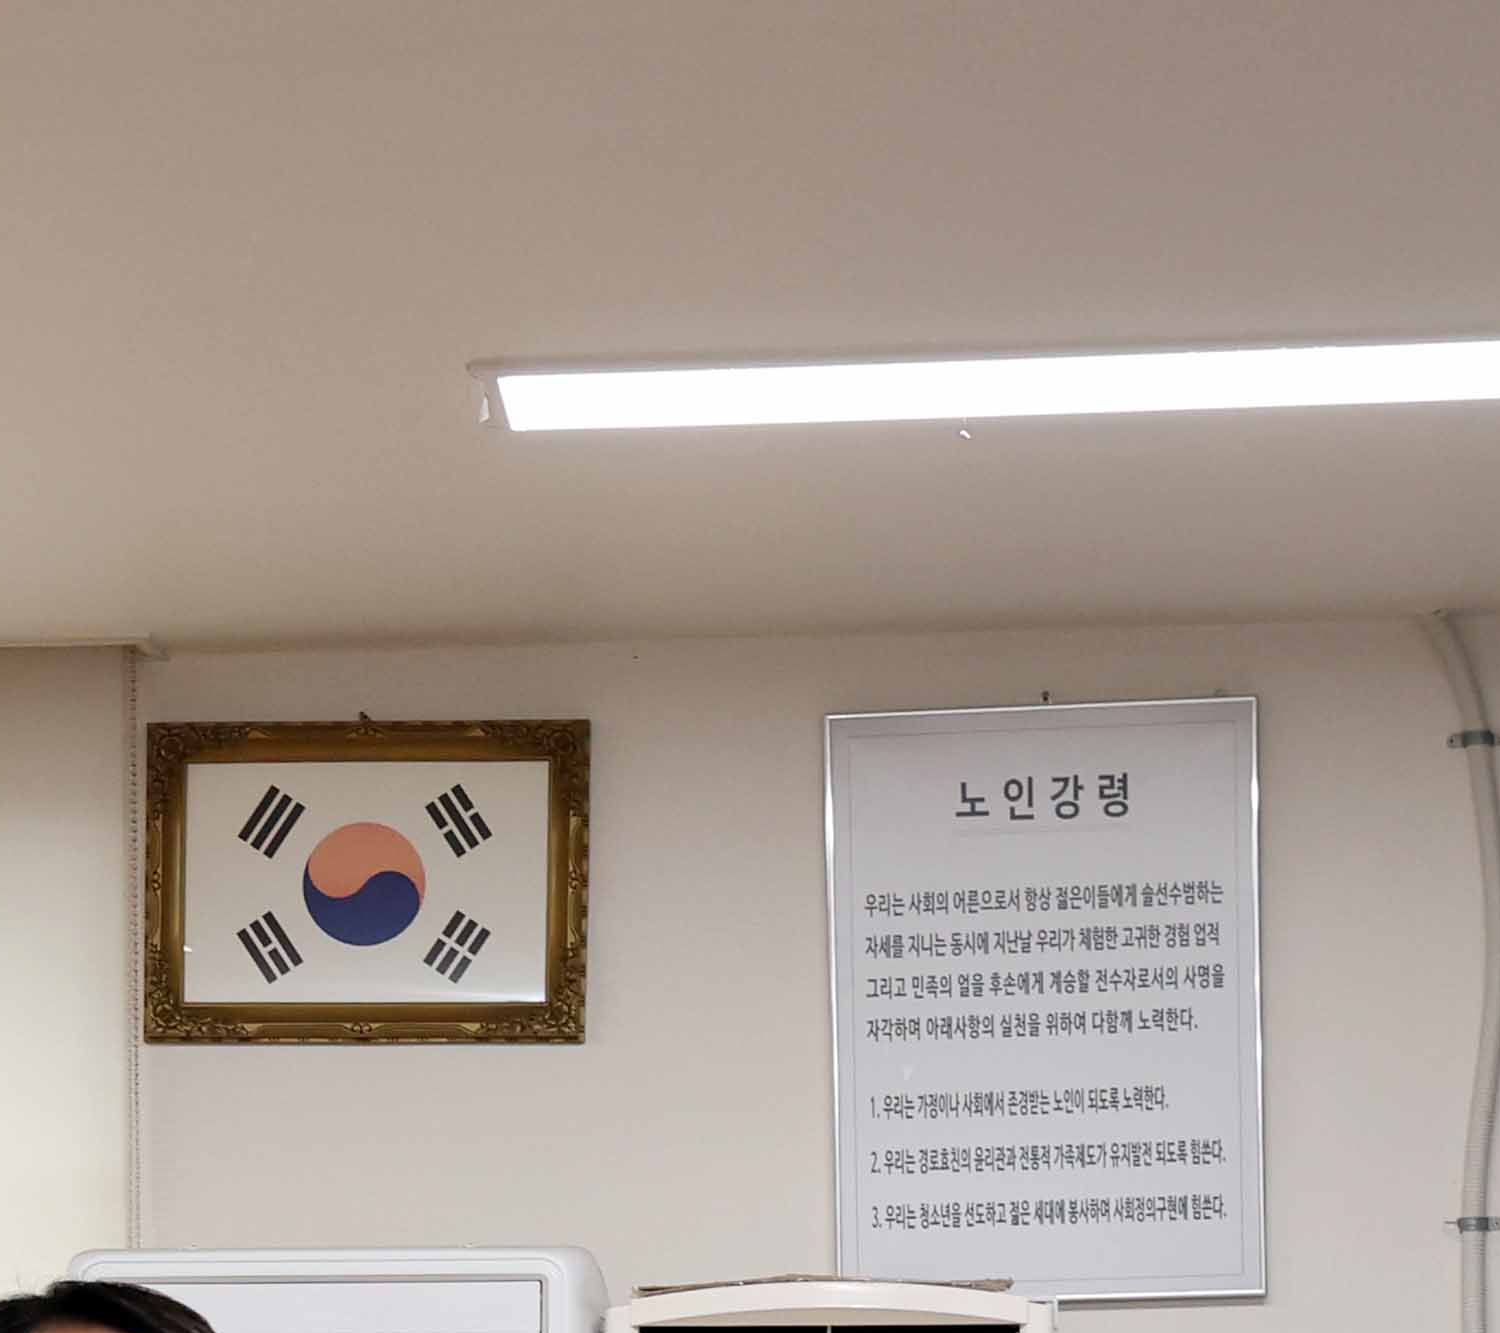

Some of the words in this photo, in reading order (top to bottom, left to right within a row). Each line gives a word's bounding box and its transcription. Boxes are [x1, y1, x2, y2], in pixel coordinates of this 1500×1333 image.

[955, 772, 1130, 821] 노인강령
[864, 892, 905, 918] 우리는
[908, 890, 949, 915] 사회의
[952, 888, 1020, 914] 어른으로서
[1024, 886, 1051, 912] 항상
[1055, 883, 1138, 910] 젊은이들에게
[1140, 880, 1224, 907] 솔선수범하는
[865, 934, 905, 959] 자세를
[908, 932, 947, 957] 지니는
[950, 930, 989, 956] 동시에
[993, 929, 1033, 954] 지난날
[1036, 927, 1076, 953] 우리가
[1079, 925, 1118, 951] 체험한
[1121, 924, 1161, 950] 고귀한
[1164, 923, 1191, 948] 경험
[1193, 921, 1220, 946] 업적
[865, 976, 907, 1000] 그리고
[911, 974, 952, 1000] 민족의
[958, 972, 985, 998] 얼을
[989, 971, 1045, 997] 후손에게
[1049, 968, 1090, 994] 계승할
[1095, 965, 1178, 992] 전수자로서의
[1184, 963, 1225, 989] 사명을
[866, 1016, 921, 1042] 자각하며
[926, 1013, 995, 1040] 아래사항의
[1000, 1011, 1041, 1038] 실천을
[1046, 1010, 1087, 1036] 위하여
[1092, 1008, 1134, 1035] 다함께
[1138, 1007, 1198, 1033] 노력한다.
[870, 1096, 880, 1119] 1.
[883, 1094, 915, 1120] 우리는
[918, 1092, 960, 1119] 가정이나
[963, 1090, 1005, 1118] 사회에서
[1008, 1089, 1051, 1116] 존경받는
[1053, 1087, 1085, 1114] 노인이
[1088, 1086, 1120, 1113] 되도록
[1122, 1085, 1169, 1112] 노력한다.
[870, 1151, 881, 1174] 2.
[883, 1149, 916, 1175] 우리는
[919, 1147, 971, 1174] 경로효친의
[974, 1145, 1016, 1173] 윤리관과
[1019, 1144, 1051, 1170] 전통적
[1054, 1141, 1107, 1169] 가족제도가
[1110, 1140, 1152, 1168] 유지발전
[1155, 1139, 1188, 1166] 되도록
[1190, 1138, 1227, 1165] 힘쓴다.
[871, 1205, 882, 1228] 3.
[885, 1204, 917, 1230] 우리는
[920, 1202, 961, 1229] 청소년을
[964, 1200, 1007, 1228] 선도하고
[1033, 1198, 1066, 1225] 세대에
[1068, 1197, 1111, 1224] 봉사하며
[1191, 1193, 1227, 1220] 힘쓴다.
